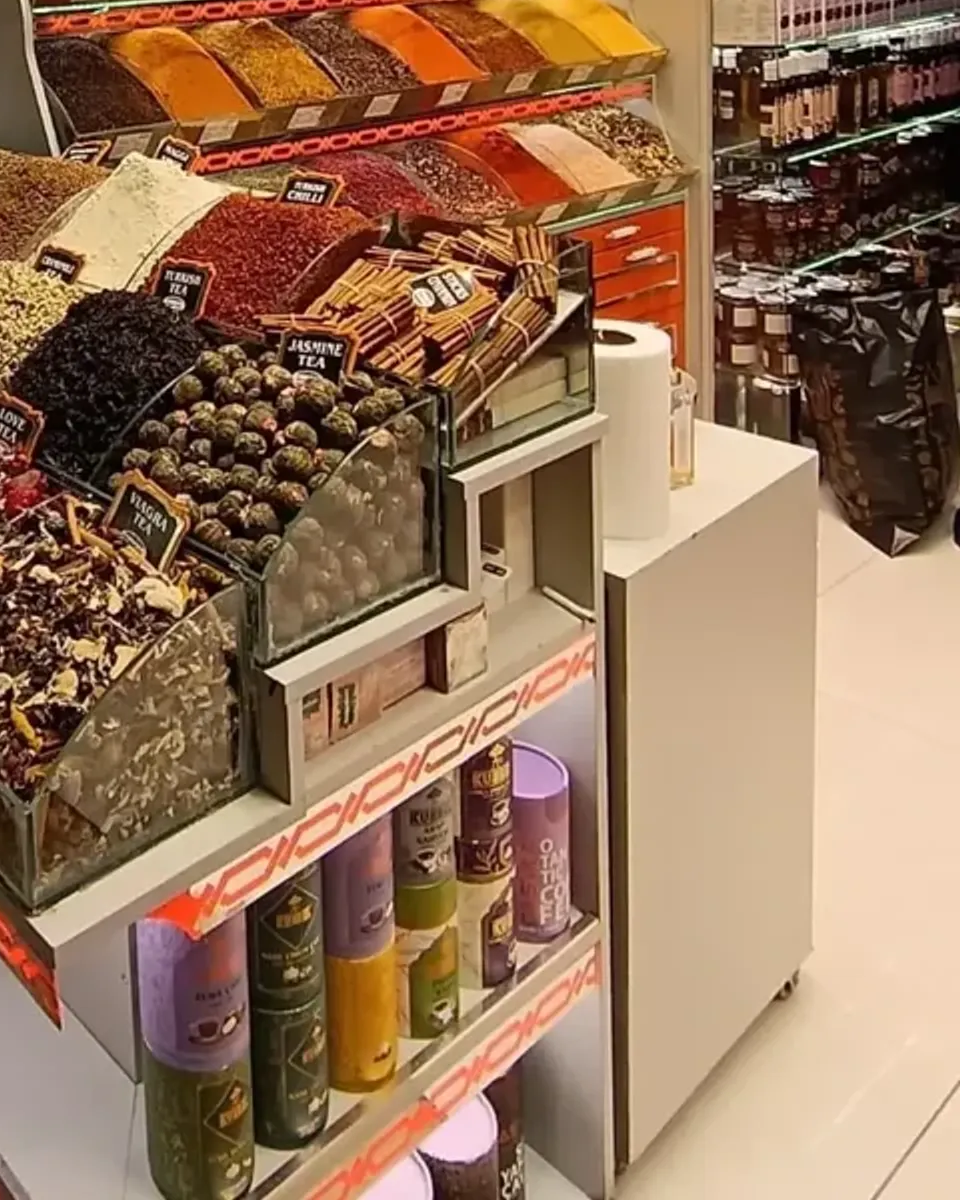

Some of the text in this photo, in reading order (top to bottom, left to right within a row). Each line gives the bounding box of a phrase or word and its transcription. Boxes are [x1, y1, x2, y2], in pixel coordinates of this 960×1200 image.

[285, 189, 325, 204] CHILLI
[163, 269, 203, 286] TURKISH
[167, 281, 189, 297] TEA
[288, 337, 344, 358] JASMINE
[297, 354, 327, 370] TEA
[129, 491, 169, 533] VIAGRA
[133, 511, 153, 537] TEA
